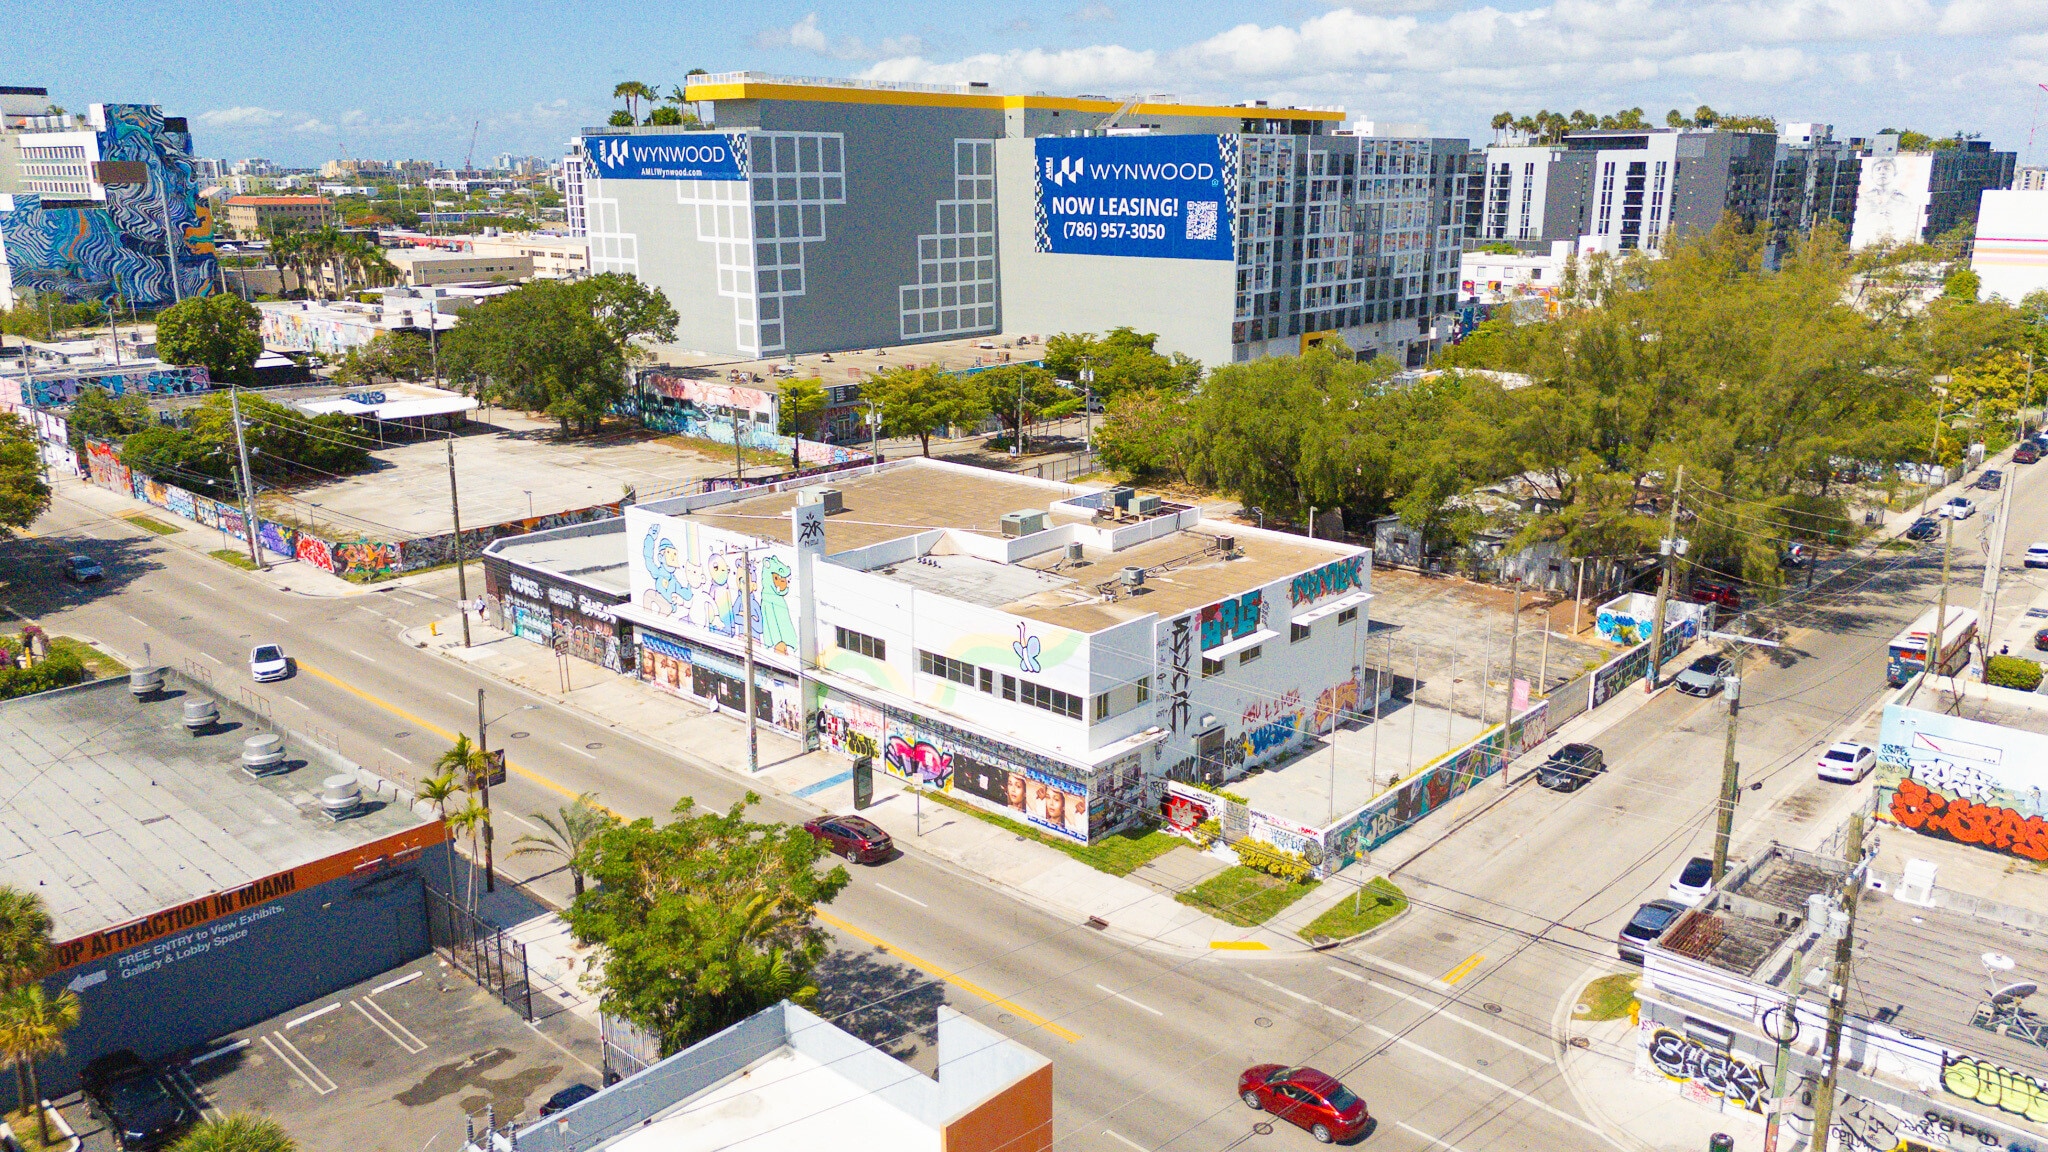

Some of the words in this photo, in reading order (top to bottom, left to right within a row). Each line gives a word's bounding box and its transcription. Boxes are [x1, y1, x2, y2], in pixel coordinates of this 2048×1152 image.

[632, 146, 725, 163] WYNWOOD
[641, 167, 702, 178] AMLIWynwood.com
[1090, 163, 1213, 180] WYNWOOD
[1052, 197, 1095, 215] NOW
[1099, 198, 1178, 217] LEASING!
[1063, 221, 1097, 240] (786)
[1101, 223, 1166, 240] 957-3050
[91, 903, 209, 957] ATTRACTION
[214, 893, 234, 917] IN
[239, 871, 296, 907] MIAMI
[118, 948, 151, 968] FREE
[153, 934, 194, 955] ENTRY
[195, 930, 209, 941] to
[210, 920, 237, 935] View
[239, 903, 286, 926] Exhibits,
[121, 957, 163, 979] Gallery
[165, 954, 175, 964] &
[176, 940, 212, 960] Lobby
[213, 928, 248, 947] Space
